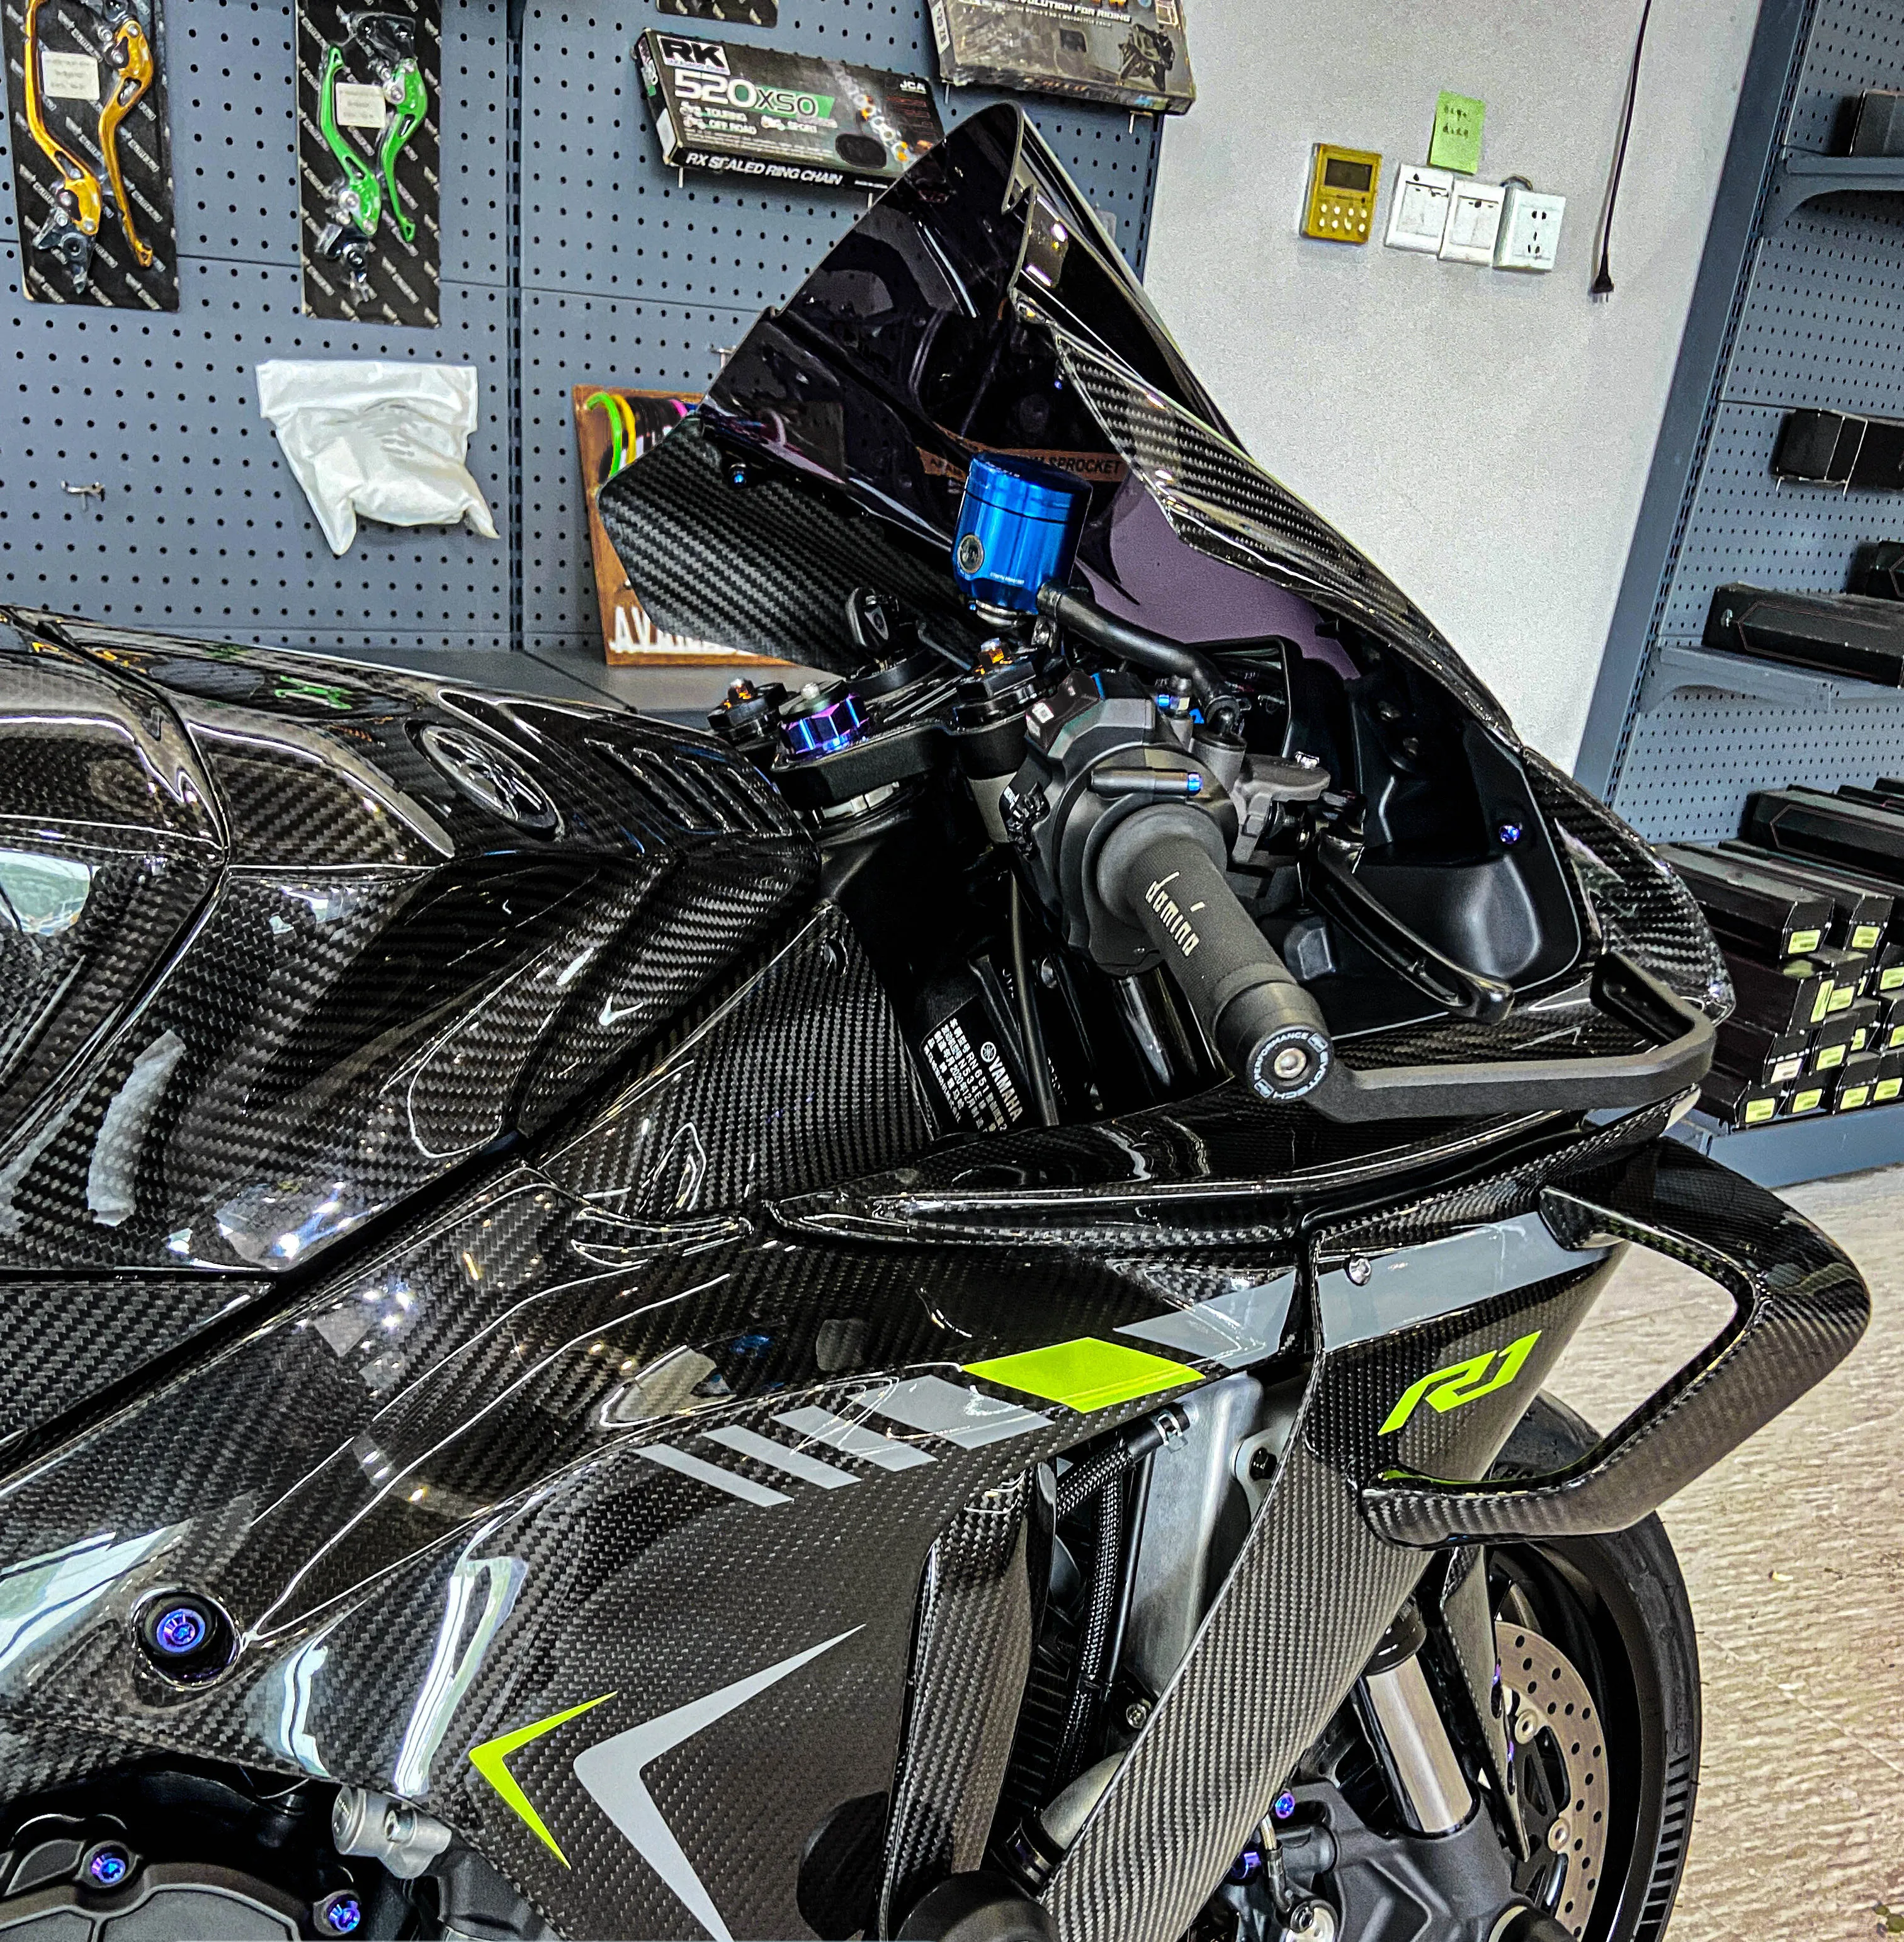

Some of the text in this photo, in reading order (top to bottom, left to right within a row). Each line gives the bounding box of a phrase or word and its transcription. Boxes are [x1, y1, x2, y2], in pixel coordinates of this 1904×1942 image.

[1074, 4, 1096, 16] FOR
[1096, 9, 1131, 23] RIDING
[660, 37, 725, 68] RK
[686, 152, 710, 166] RX
[708, 156, 766, 174] SEALED
[765, 164, 802, 179] RING
[800, 169, 843, 185] CHAIN
[1049, 457, 1121, 474] SPROCKET
[1145, 871, 1205, 957] domino
[1253, 1031, 1309, 1080] PERFORMANCE
[989, 1055, 1023, 1122] YAMAHA
[1377, 1329, 1543, 1436] R1
